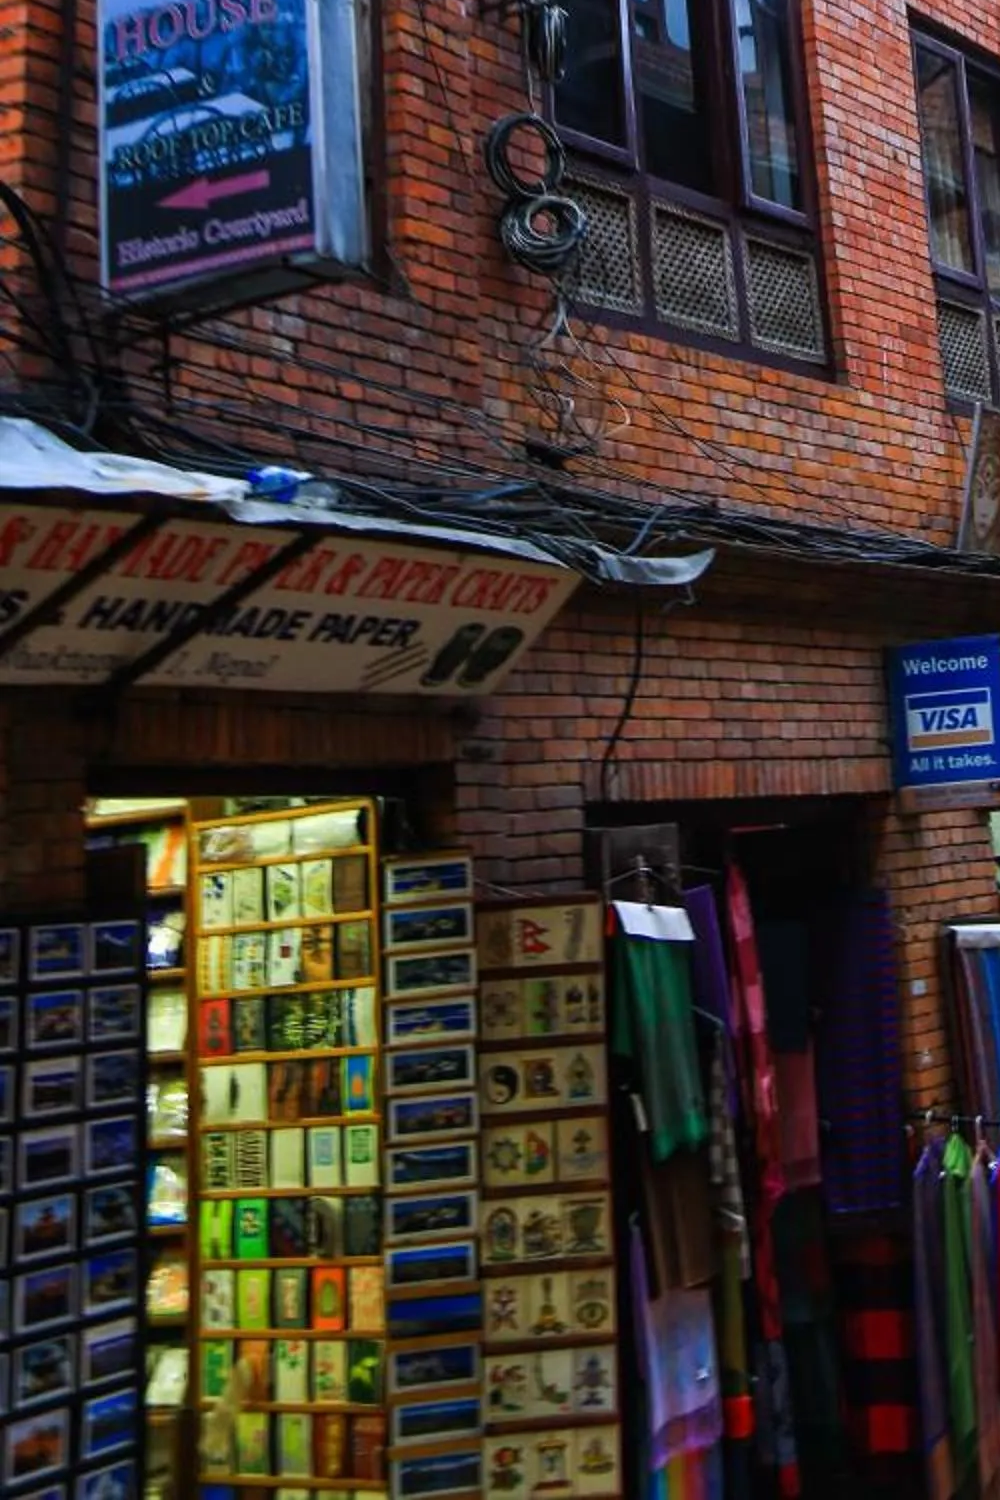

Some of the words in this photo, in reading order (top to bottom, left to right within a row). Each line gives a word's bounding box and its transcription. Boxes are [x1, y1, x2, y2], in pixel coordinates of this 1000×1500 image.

[355, 556, 459, 604] PAPER
[307, 612, 422, 648] PAPER
[903, 654, 988, 677] Welcome
[919, 706, 979, 732] VISA
[909, 756, 930, 773] All
[932, 754, 946, 771] it
